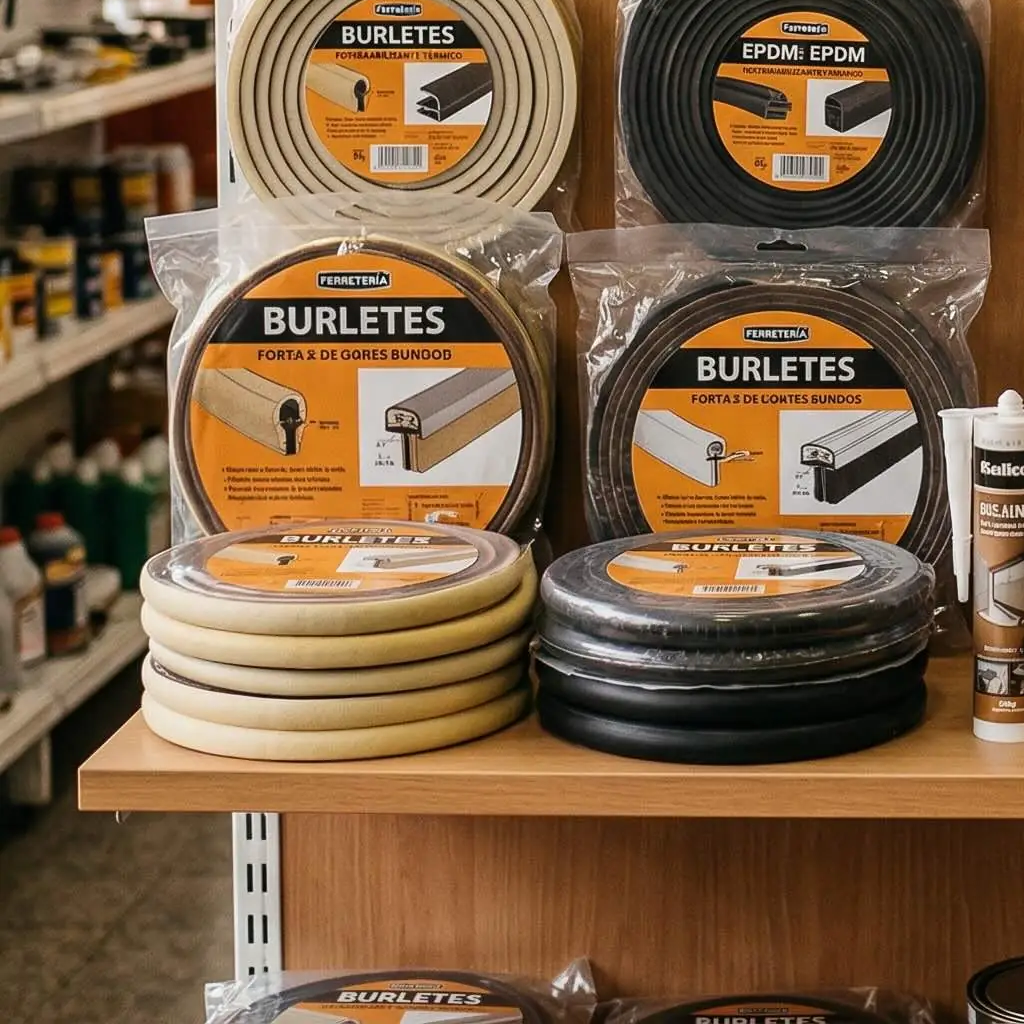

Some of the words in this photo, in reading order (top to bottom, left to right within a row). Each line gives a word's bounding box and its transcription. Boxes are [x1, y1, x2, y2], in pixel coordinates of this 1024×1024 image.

[342, 25, 455, 45] BURLETES
[809, 45, 865, 63] EPDM
[264, 306, 445, 335] BURLETES
[320, 349, 338, 361] DE
[697, 356, 855, 381] BURLETES
[743, 394, 758, 405] DE
[280, 535, 431, 544] BURLETES
[671, 543, 817, 552] BURLETES
[337, 991, 482, 1005] BURLETES
